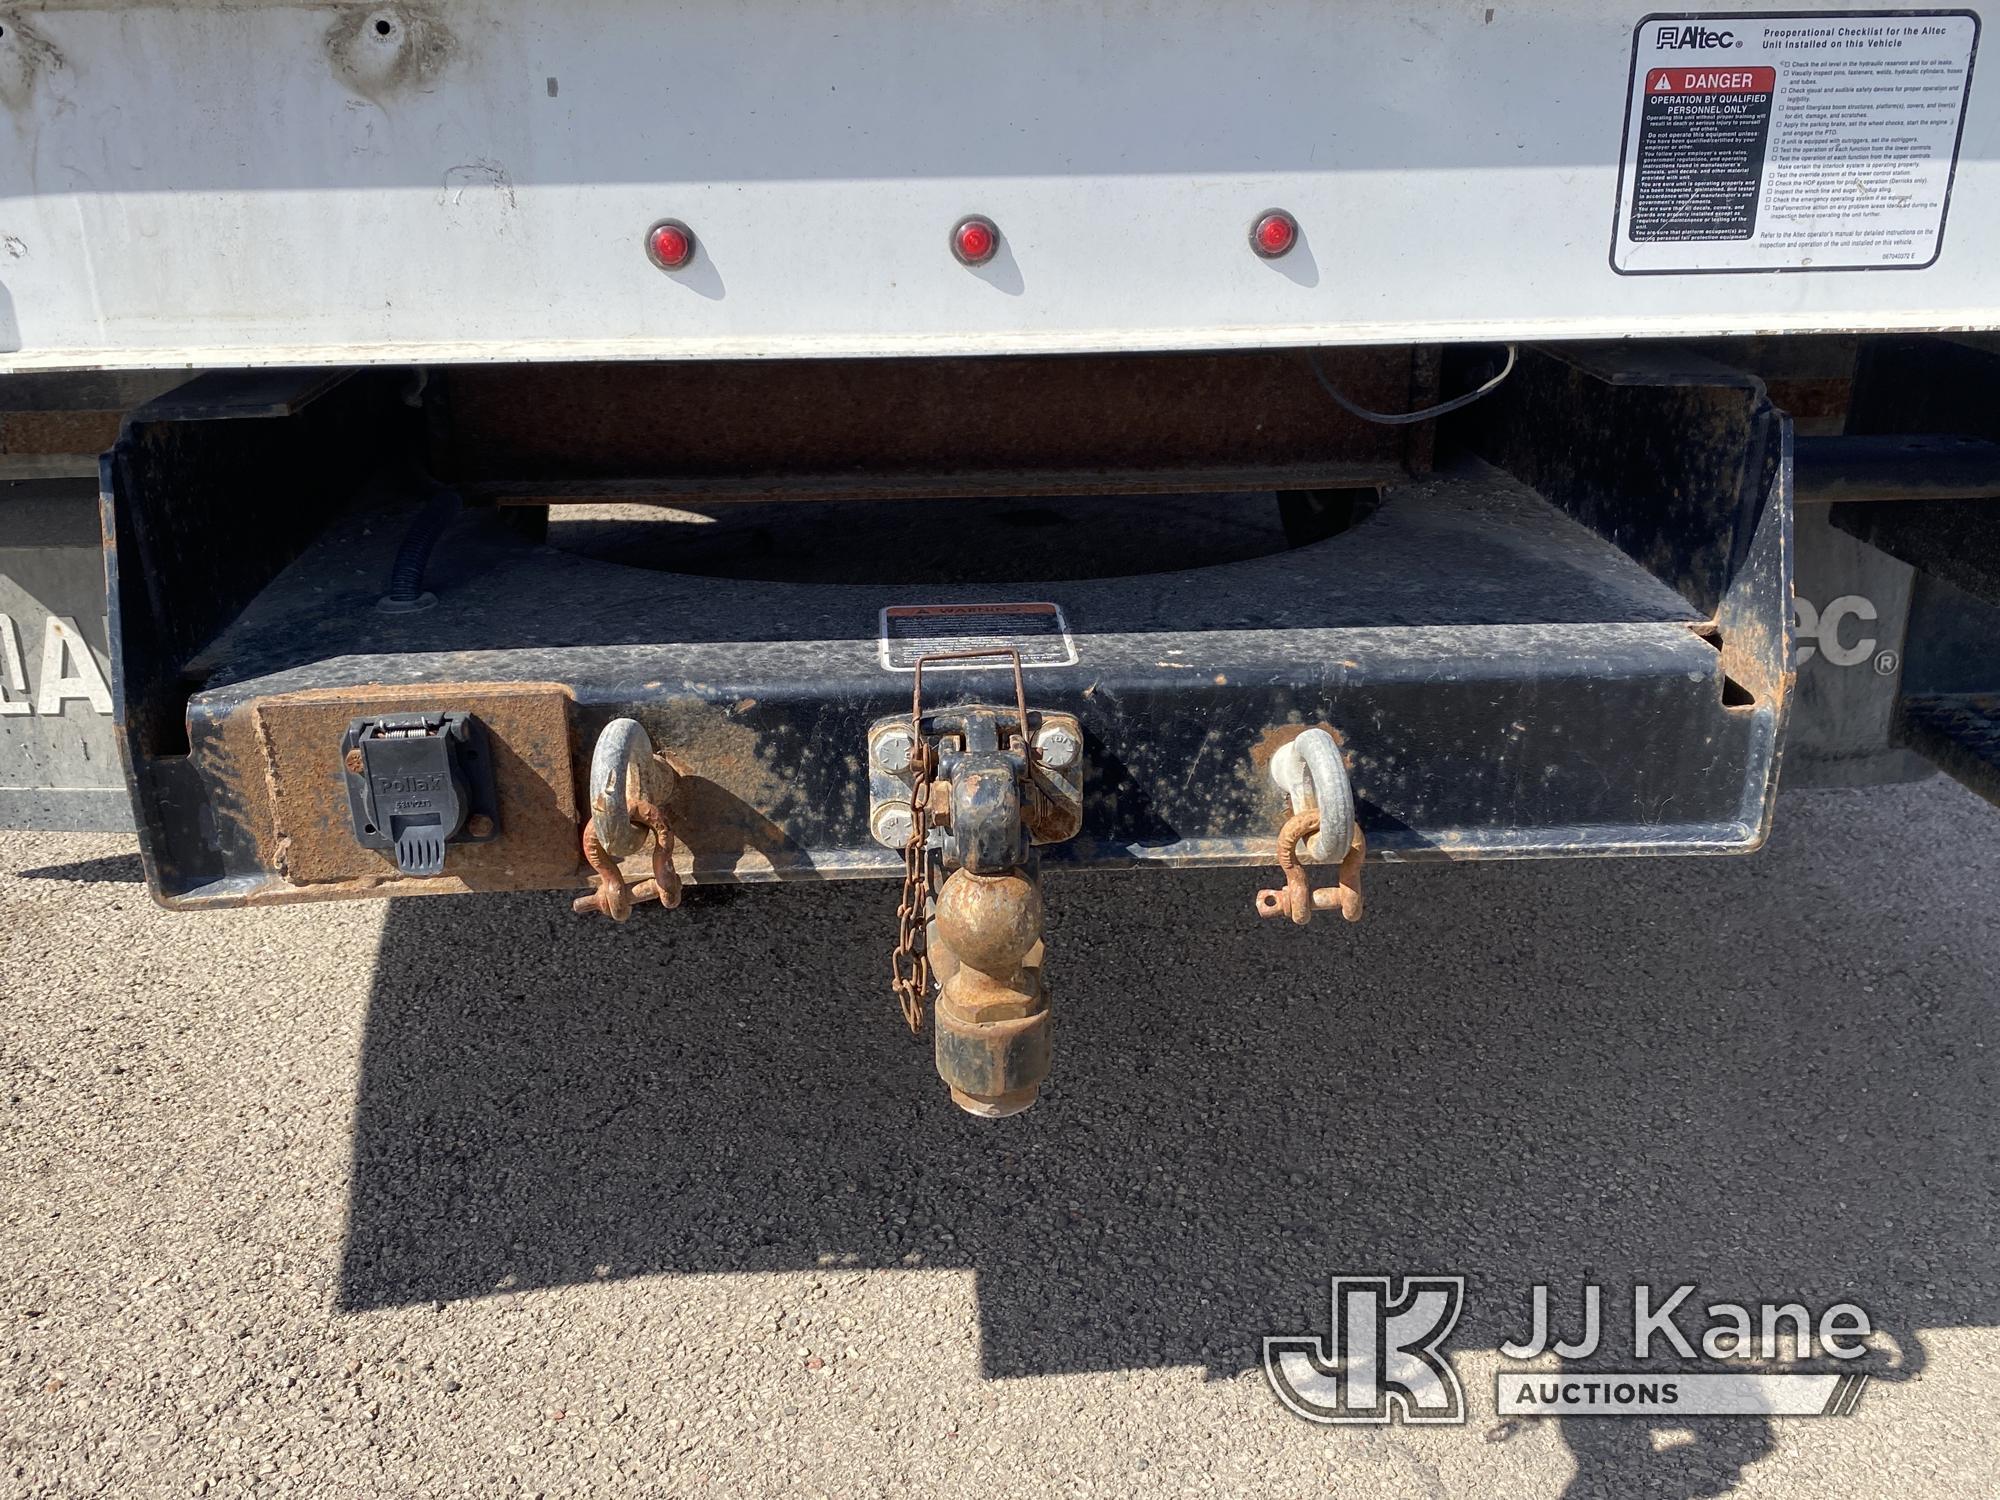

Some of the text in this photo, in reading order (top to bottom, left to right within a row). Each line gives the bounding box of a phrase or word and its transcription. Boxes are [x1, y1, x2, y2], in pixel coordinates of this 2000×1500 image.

[1763, 28, 1835, 37] Preoperational
[1836, 27, 1883, 35] Checklist
[1885, 27, 1900, 35] for
[1762, 40, 1782, 48] Unit
[1844, 39, 1864, 47] this
[1865, 39, 1902, 47] Vehicle
[1684, 72, 1753, 88] DANGER
[1650, 95, 1702, 103] OPERATION
[1718, 94, 1766, 102] QUALIFIED
[1723, 105, 1747, 113] ONLY
[378, 775, 444, 793] Pollak
